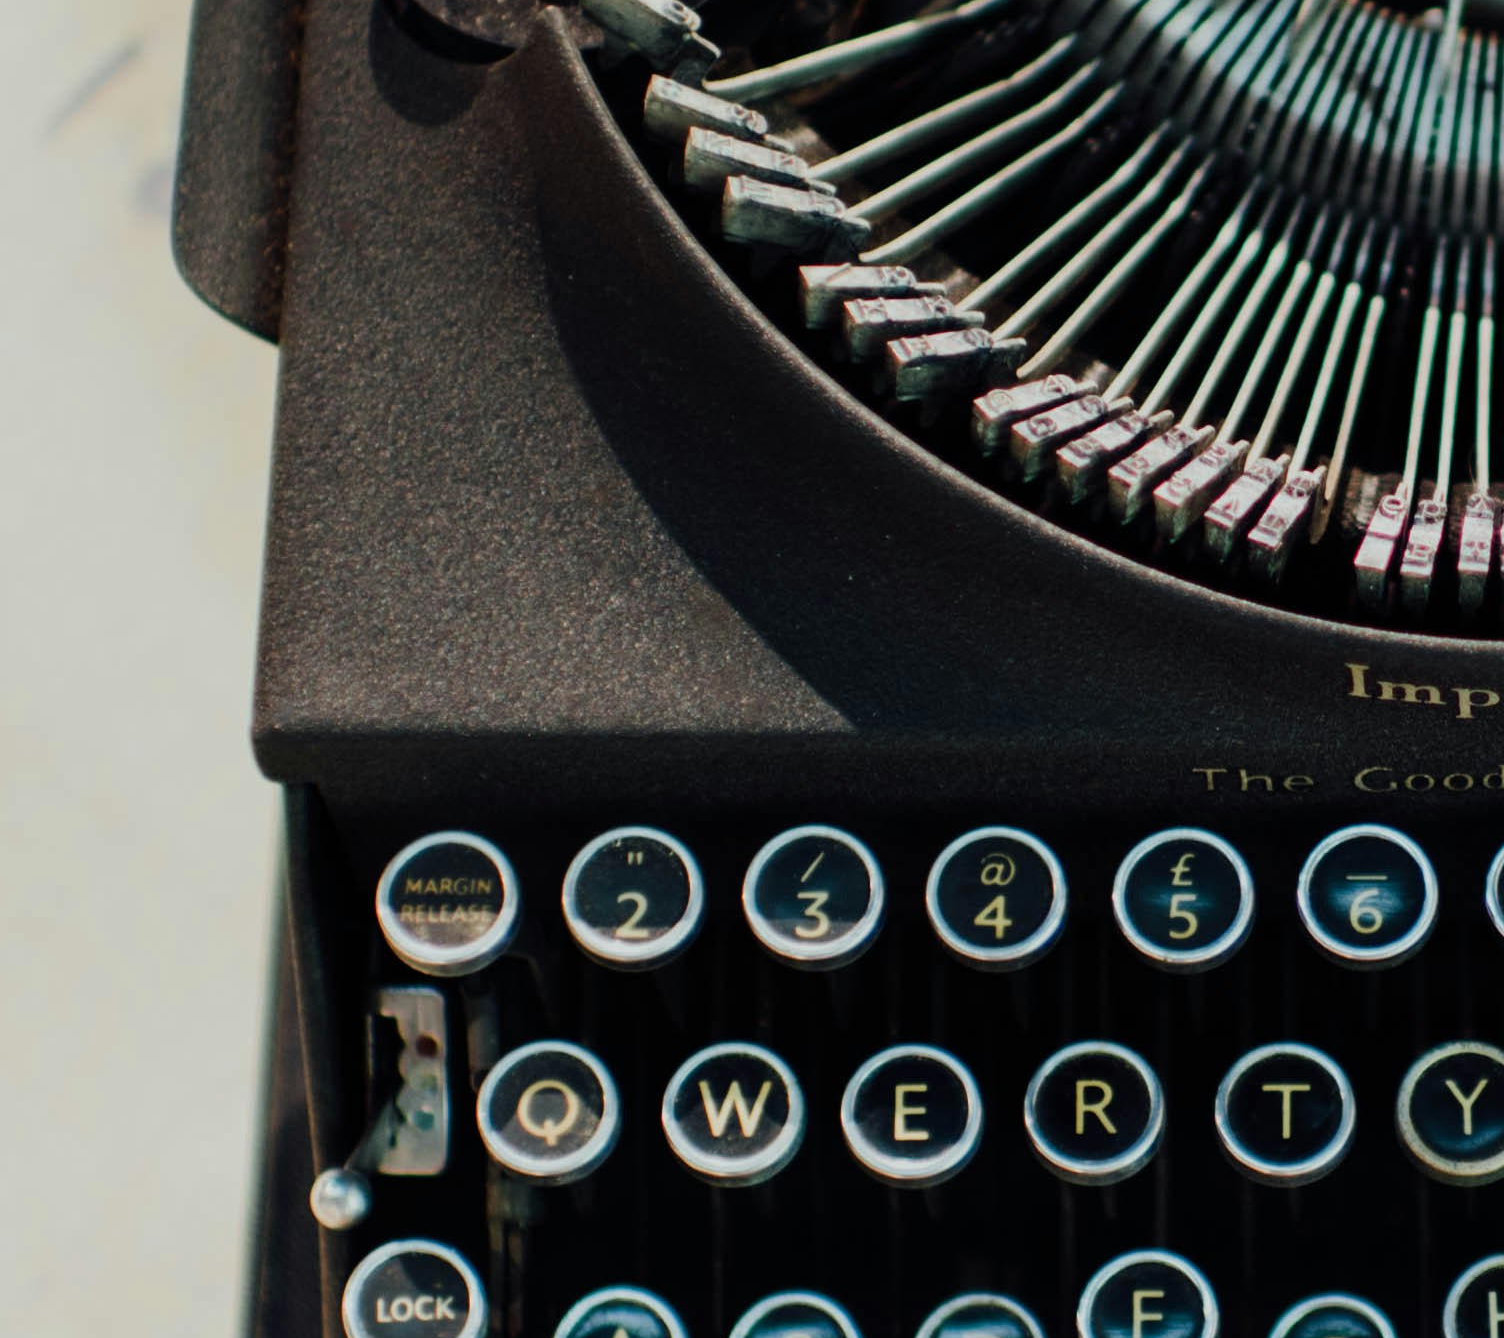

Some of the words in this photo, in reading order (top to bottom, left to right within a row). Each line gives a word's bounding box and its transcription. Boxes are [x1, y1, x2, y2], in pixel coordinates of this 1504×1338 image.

[1192, 766, 1315, 793] The
[405, 876, 493, 896] MARGIN
[979, 852, 1017, 887] @
[1169, 853, 1195, 887] £
[400, 903, 497, 924] RELEASE
[615, 892, 649, 939] 2
[794, 891, 830, 939] 3
[973, 895, 1013, 940] 4
[1168, 893, 1199, 940] 5
[1348, 887, 1383, 935] 6
[516, 1078, 580, 1146] Q
[698, 1079, 773, 1139] W
[893, 1083, 931, 1142] E
[1075, 1079, 1118, 1136] R
[1261, 1083, 1312, 1140] T
[1444, 1078, 1489, 1136] Y
[375, 1294, 457, 1324] LOCK
